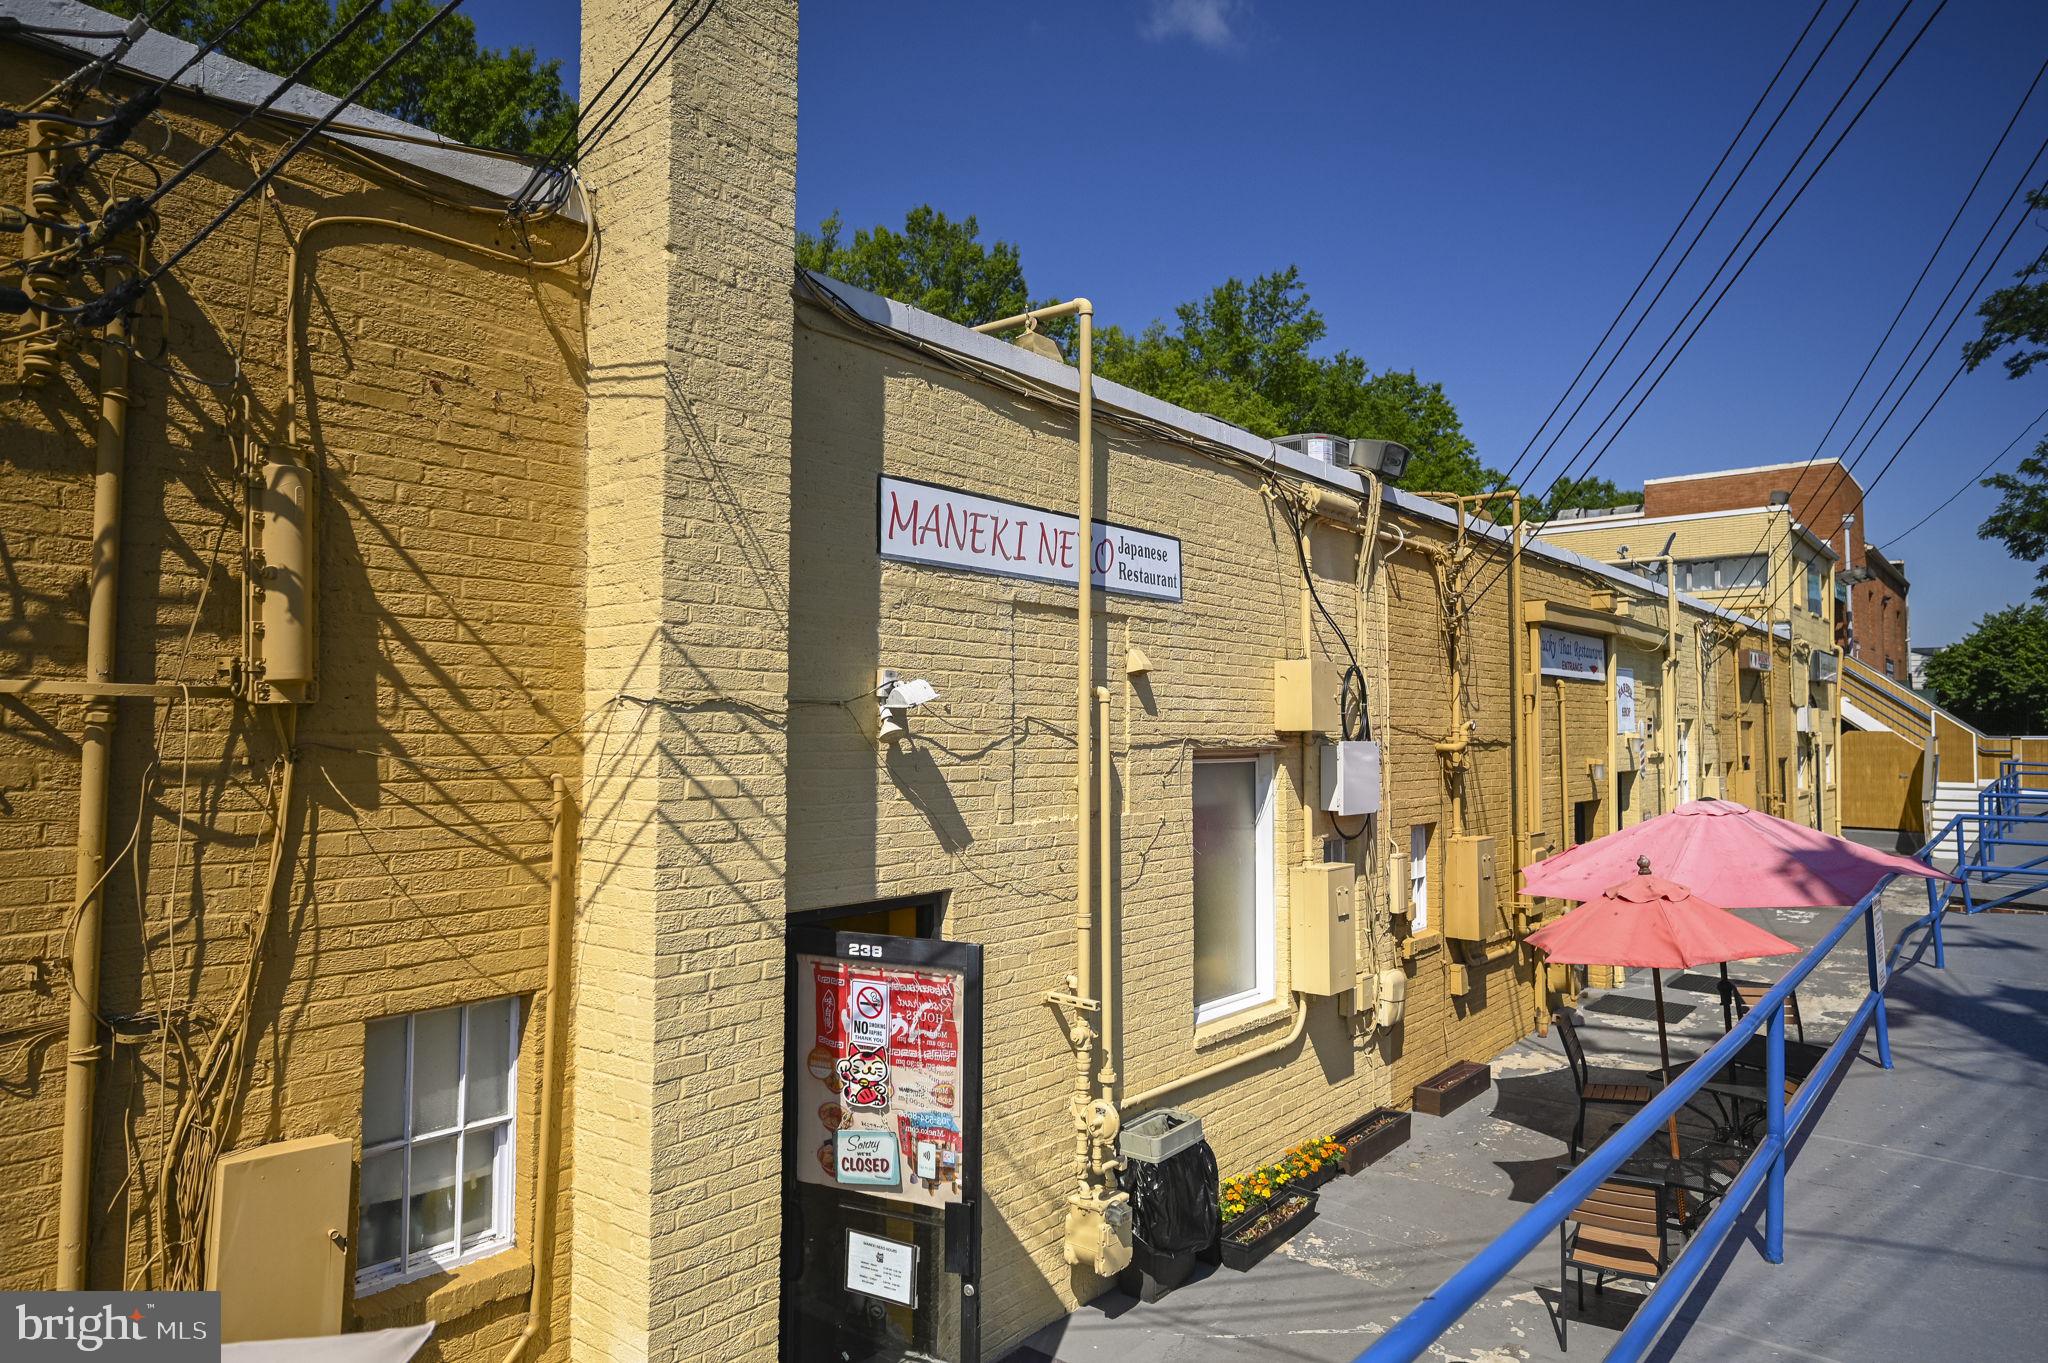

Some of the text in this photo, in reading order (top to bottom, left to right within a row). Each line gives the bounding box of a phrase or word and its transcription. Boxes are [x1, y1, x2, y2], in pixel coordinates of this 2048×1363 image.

[888, 491, 1028, 561] MANEKI
[1118, 535, 1168, 563] Japanese
[1118, 562, 1178, 590] Restaurant
[1541, 634, 1603, 660] ucky Thai Restaurant
[1561, 660, 1583, 672] ENTRANCE
[848, 943, 883, 958] 238
[854, 1020, 868, 1035] NO
[868, 1022, 886, 1030] SMOKING
[854, 1034, 872, 1042] THANK
[847, 1134, 880, 1153] Sorry
[841, 1157, 890, 1173] CLOSED
